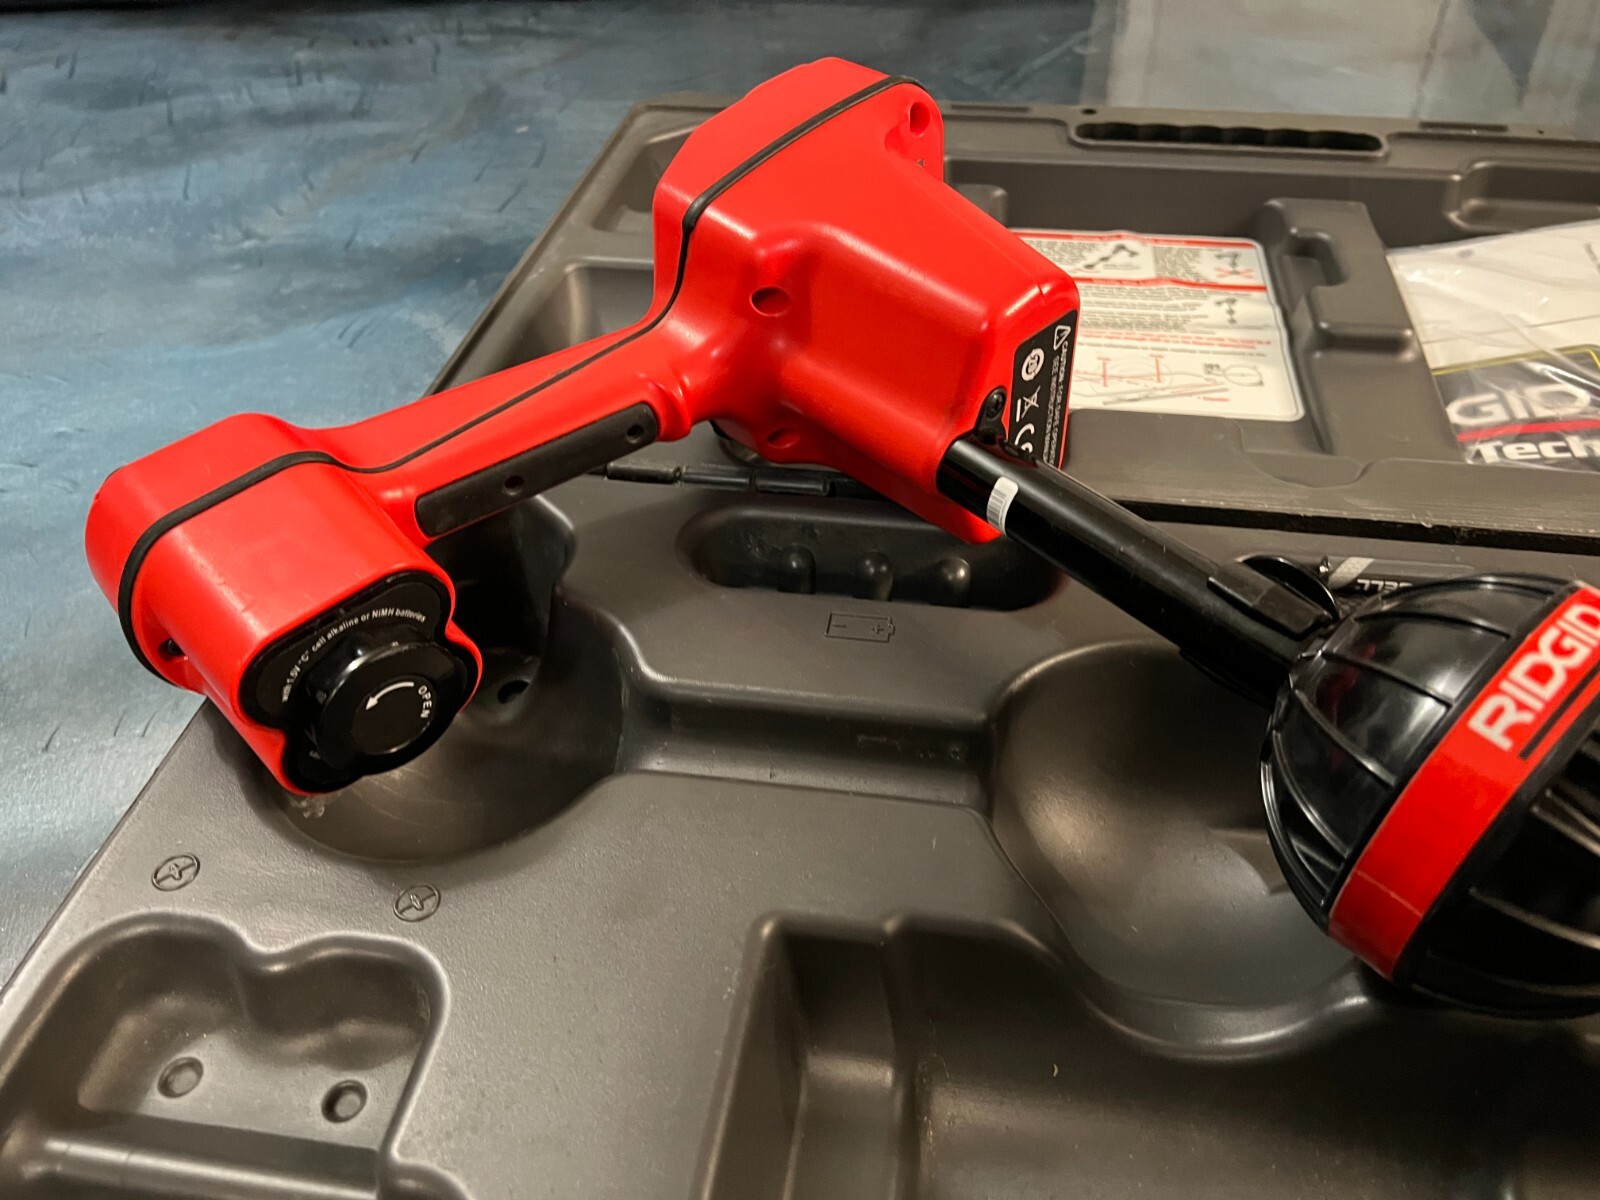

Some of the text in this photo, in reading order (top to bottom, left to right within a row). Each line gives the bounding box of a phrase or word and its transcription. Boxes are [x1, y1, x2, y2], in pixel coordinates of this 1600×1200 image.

[312, 636, 327, 652] cell
[326, 617, 359, 640] alkaline
[361, 612, 371, 623] or
[371, 608, 395, 620] NiMH
[395, 608, 427, 624] batteries
[1467, 603, 1600, 752] RIDGID
[418, 685, 433, 719] OPEN
